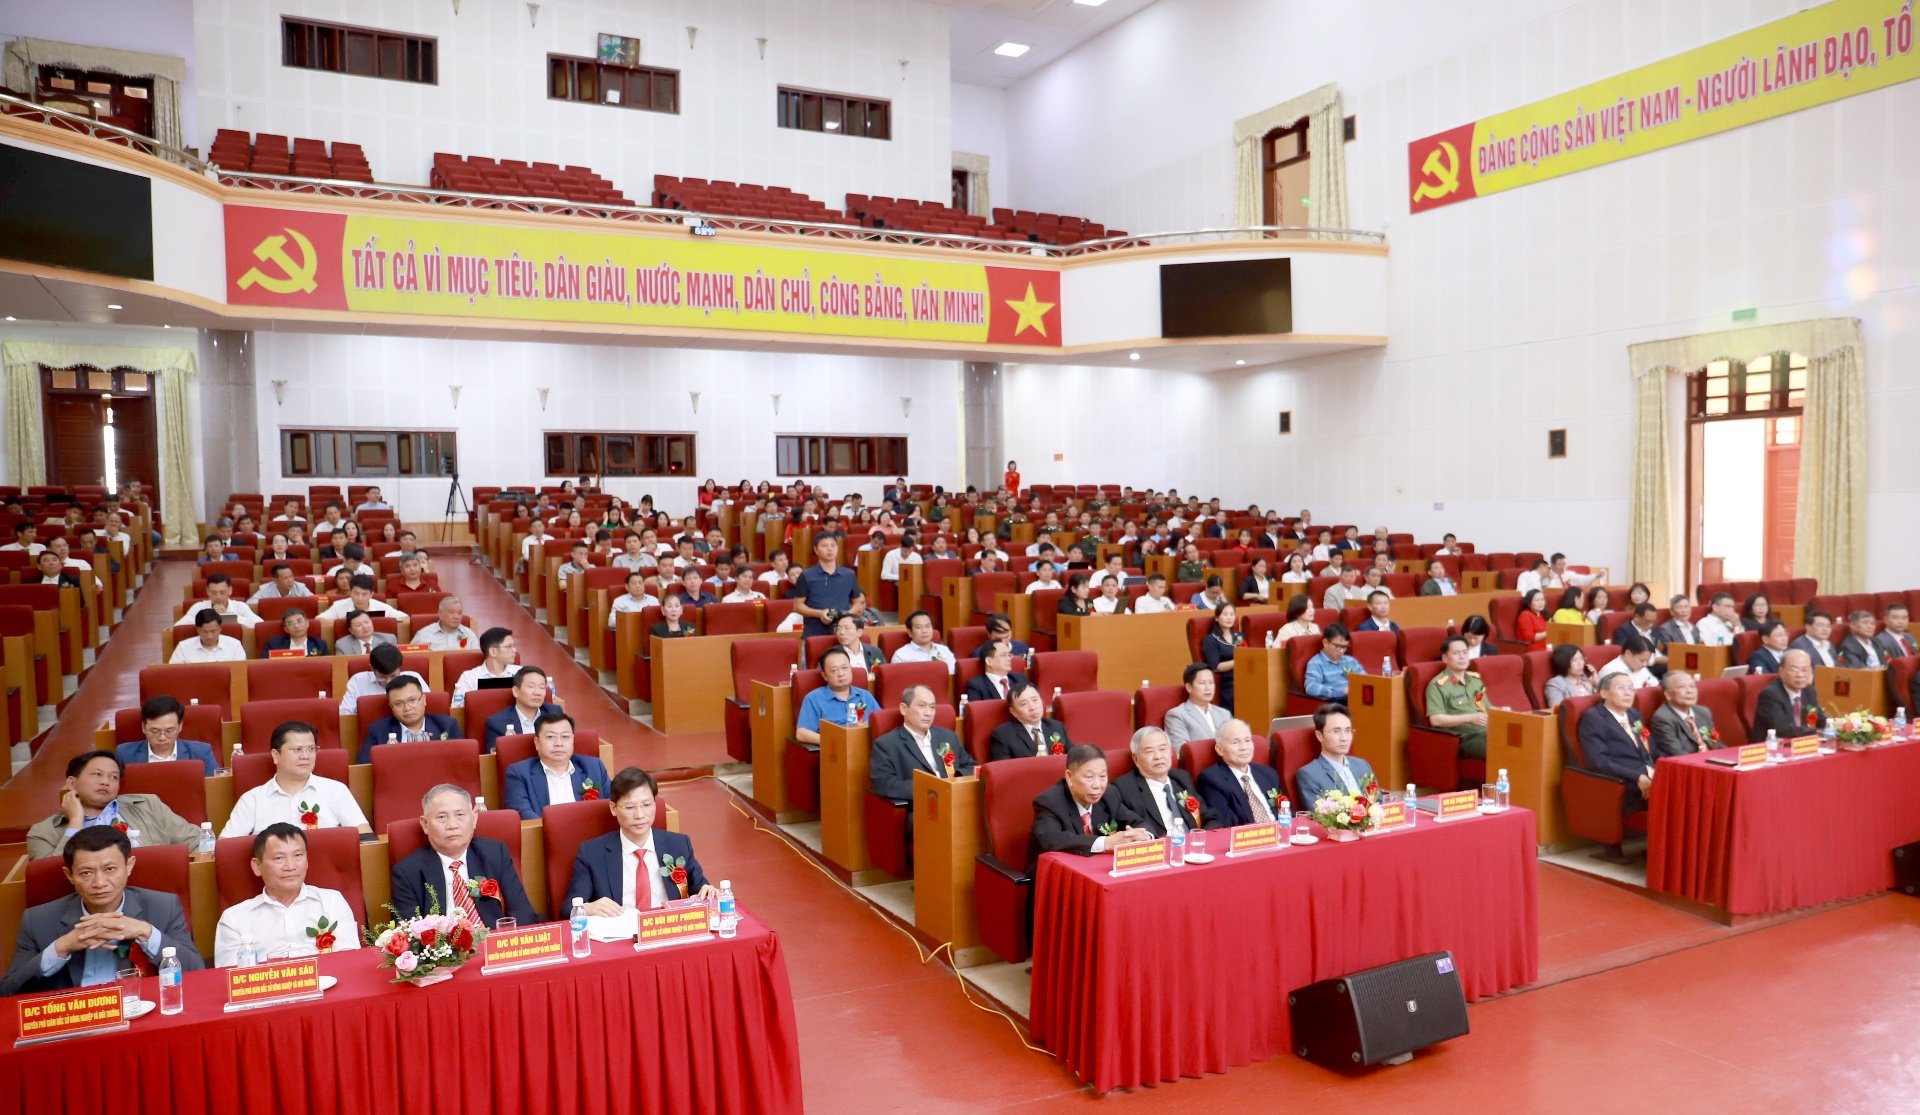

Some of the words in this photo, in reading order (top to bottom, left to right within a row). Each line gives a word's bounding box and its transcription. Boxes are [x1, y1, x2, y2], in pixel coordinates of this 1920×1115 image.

[1478, 133, 1516, 175] ĐẢNG
[1520, 125, 1560, 167] CỘNG
[1564, 106, 1596, 150] SẢN
[1600, 97, 1635, 143] VIỆT
[1640, 86, 1680, 129] NAM
[1697, 56, 1756, 113] NGƯỜI
[1763, 46, 1817, 92] LÃNH
[1824, 26, 1876, 79] ĐẠO,
[351, 236, 386, 289] TẤT
[392, 239, 419, 291] CẢ
[423, 246, 441, 293] VÌ
[447, 255, 489, 303] MỤC
[494, 252, 539, 298] TIÊU:
[544, 255, 580, 300] DÂN
[586, 258, 631, 309] GIÀU,
[636, 262, 681, 306] NƯỚC
[686, 271, 740, 316] MẠNH,
[743, 269, 776, 312] DÂN
[780, 268, 817, 318] CHỦ,
[820, 274, 860, 317] CÔNG
[864, 272, 908, 324] BẰNG,
[911, 282, 939, 321] VĂN
[943, 290, 984, 324] MINH!
[233, 974, 247, 984] Đ/C
[249, 967, 280, 983] NGUYỄN
[281, 966, 297, 978] VĂN
[24, 1006, 40, 1017] Đ/C
[42, 1001, 66, 1015] TỐNG
[67, 998, 86, 1010] VĂN
